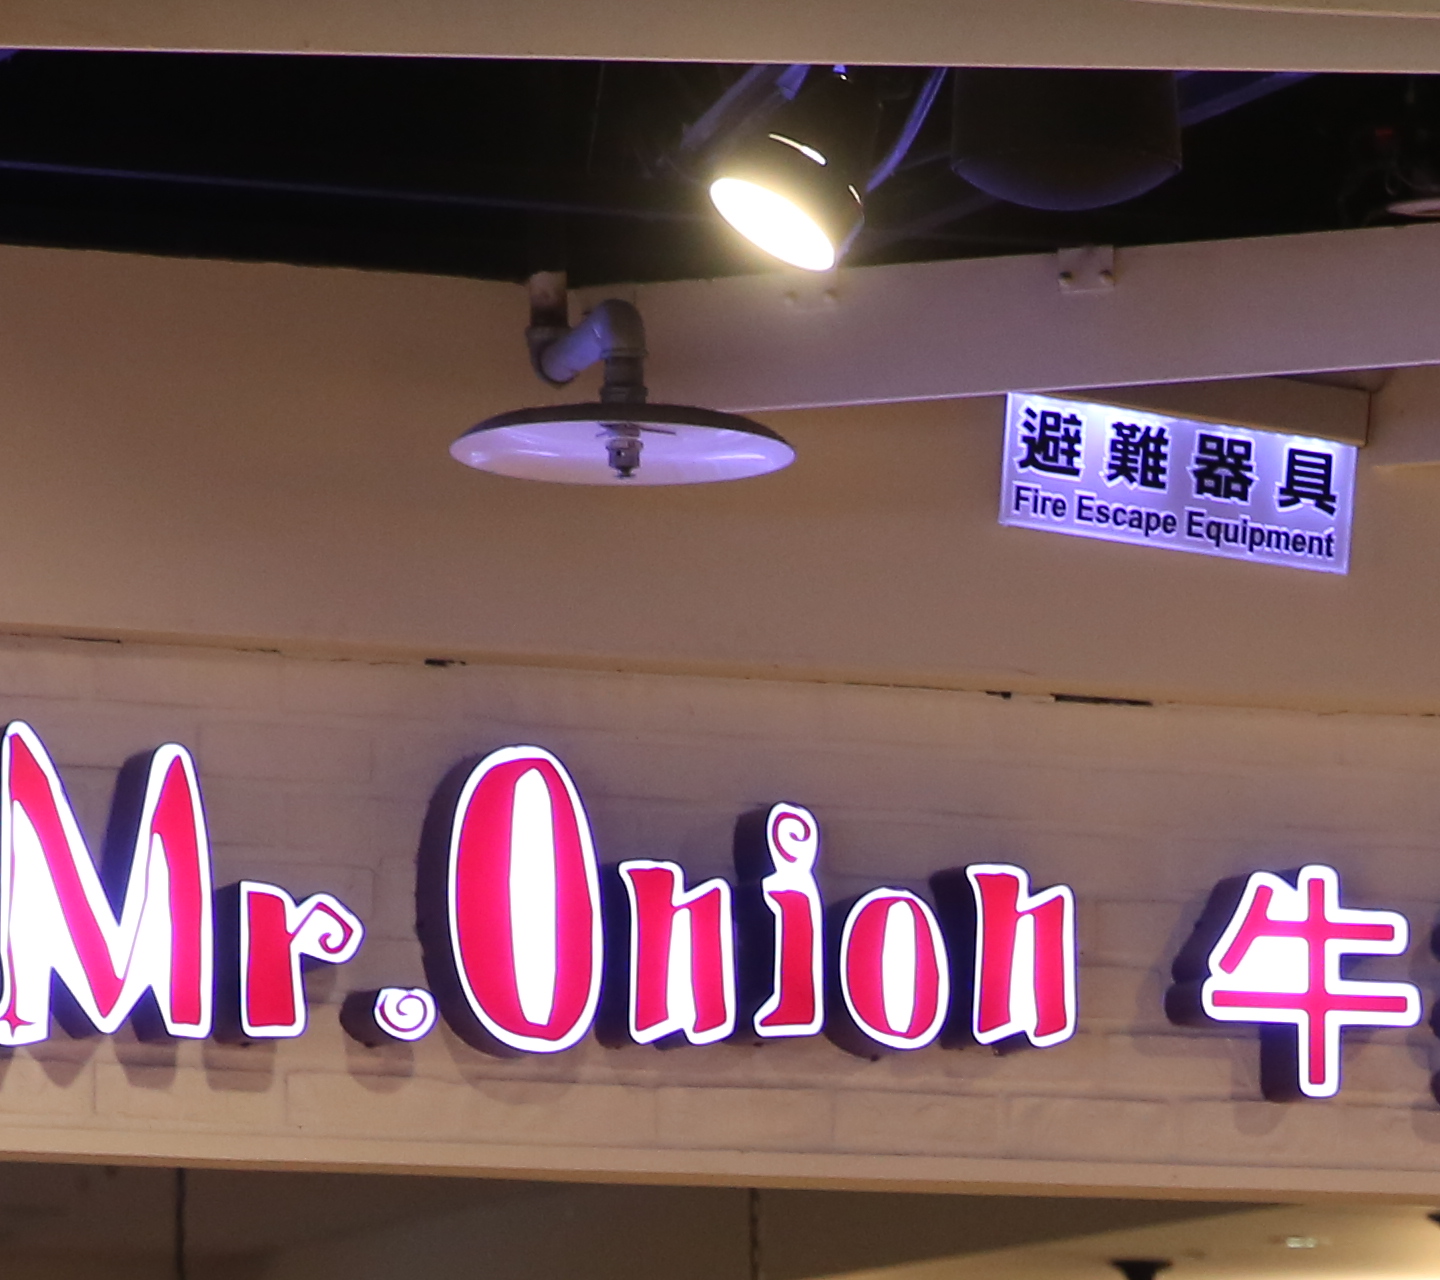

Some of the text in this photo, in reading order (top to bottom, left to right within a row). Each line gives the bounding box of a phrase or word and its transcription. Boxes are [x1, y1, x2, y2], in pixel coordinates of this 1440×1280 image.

[1017, 406, 1338, 516] 避難器具
[1013, 485, 1334, 558] Fire Escape Equipment
